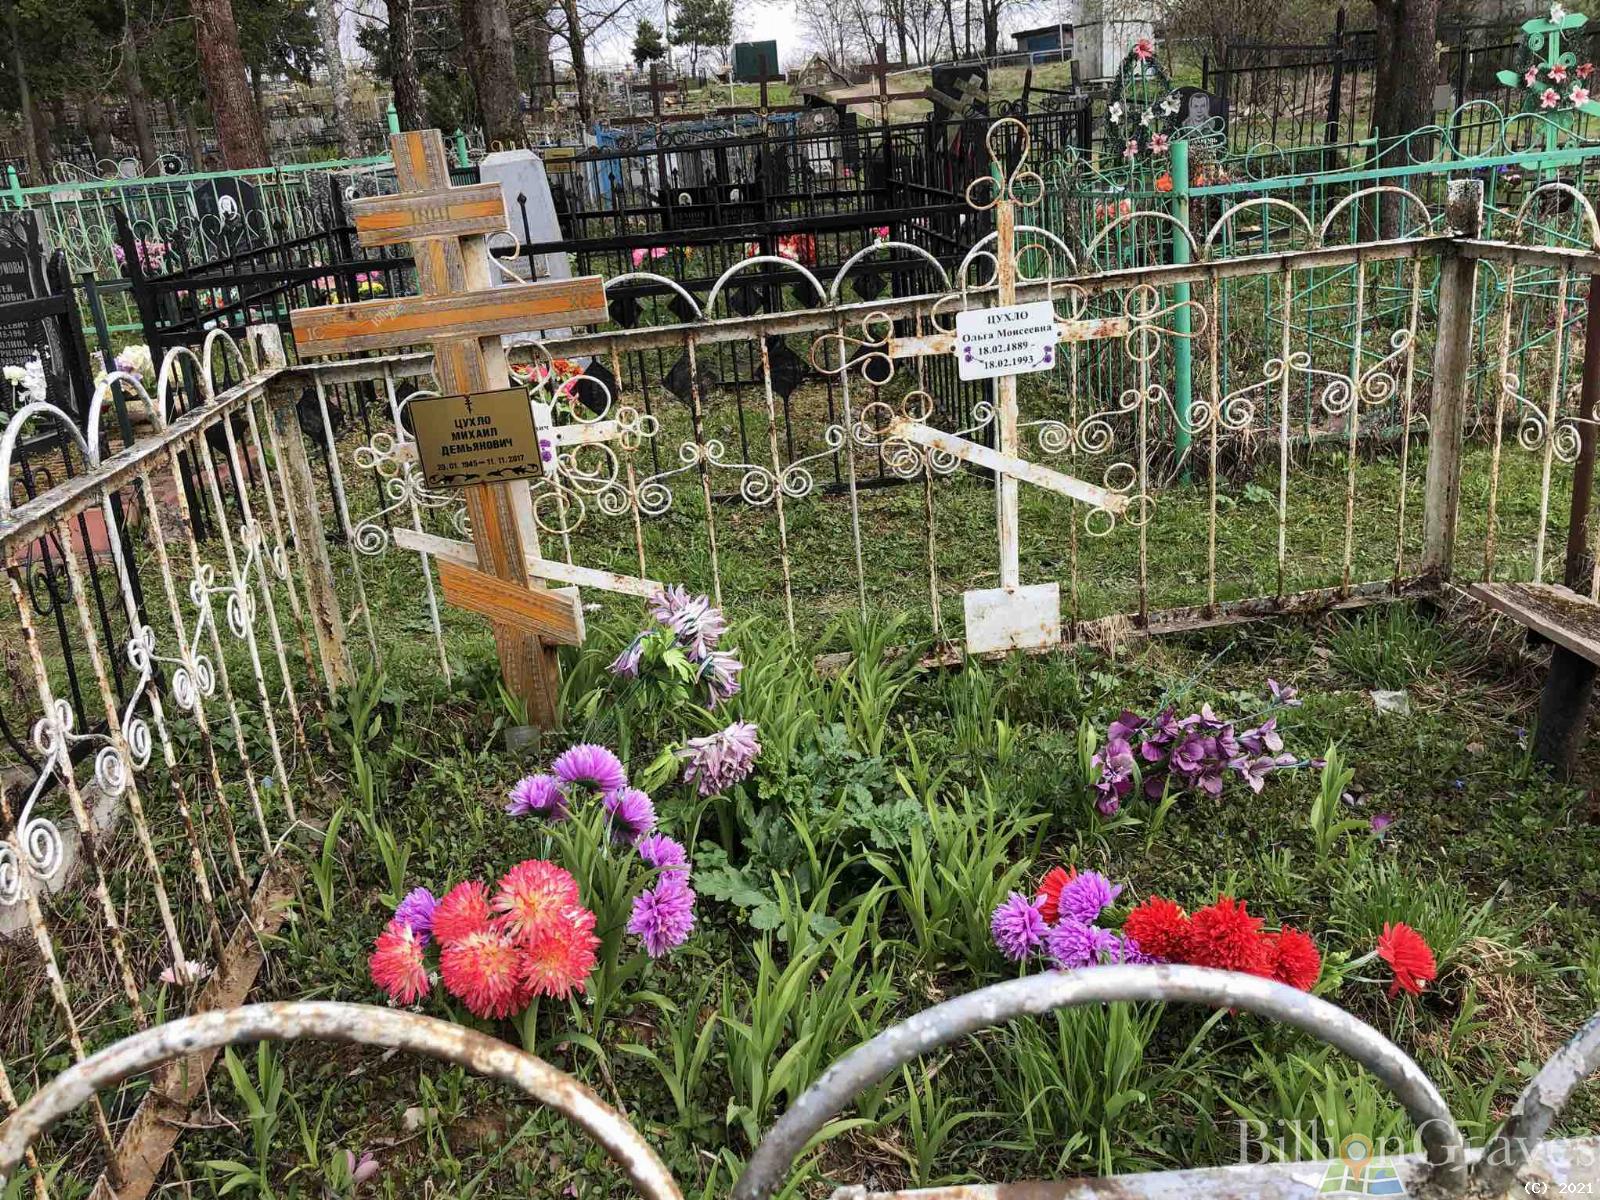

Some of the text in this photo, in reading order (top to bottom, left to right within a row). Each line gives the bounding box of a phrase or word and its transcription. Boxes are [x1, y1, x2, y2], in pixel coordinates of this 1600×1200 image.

[962, 324, 1052, 343] Ольга Моисеевна
[979, 341, 1028, 356] 18.02.1889
[984, 355, 1034, 370] 18.02.1993
[454, 416, 491, 430] ЦУХЛО
[451, 427, 498, 441] МИХАИЛ
[441, 439, 513, 457] ДЕМЬЯНОВИЧ
